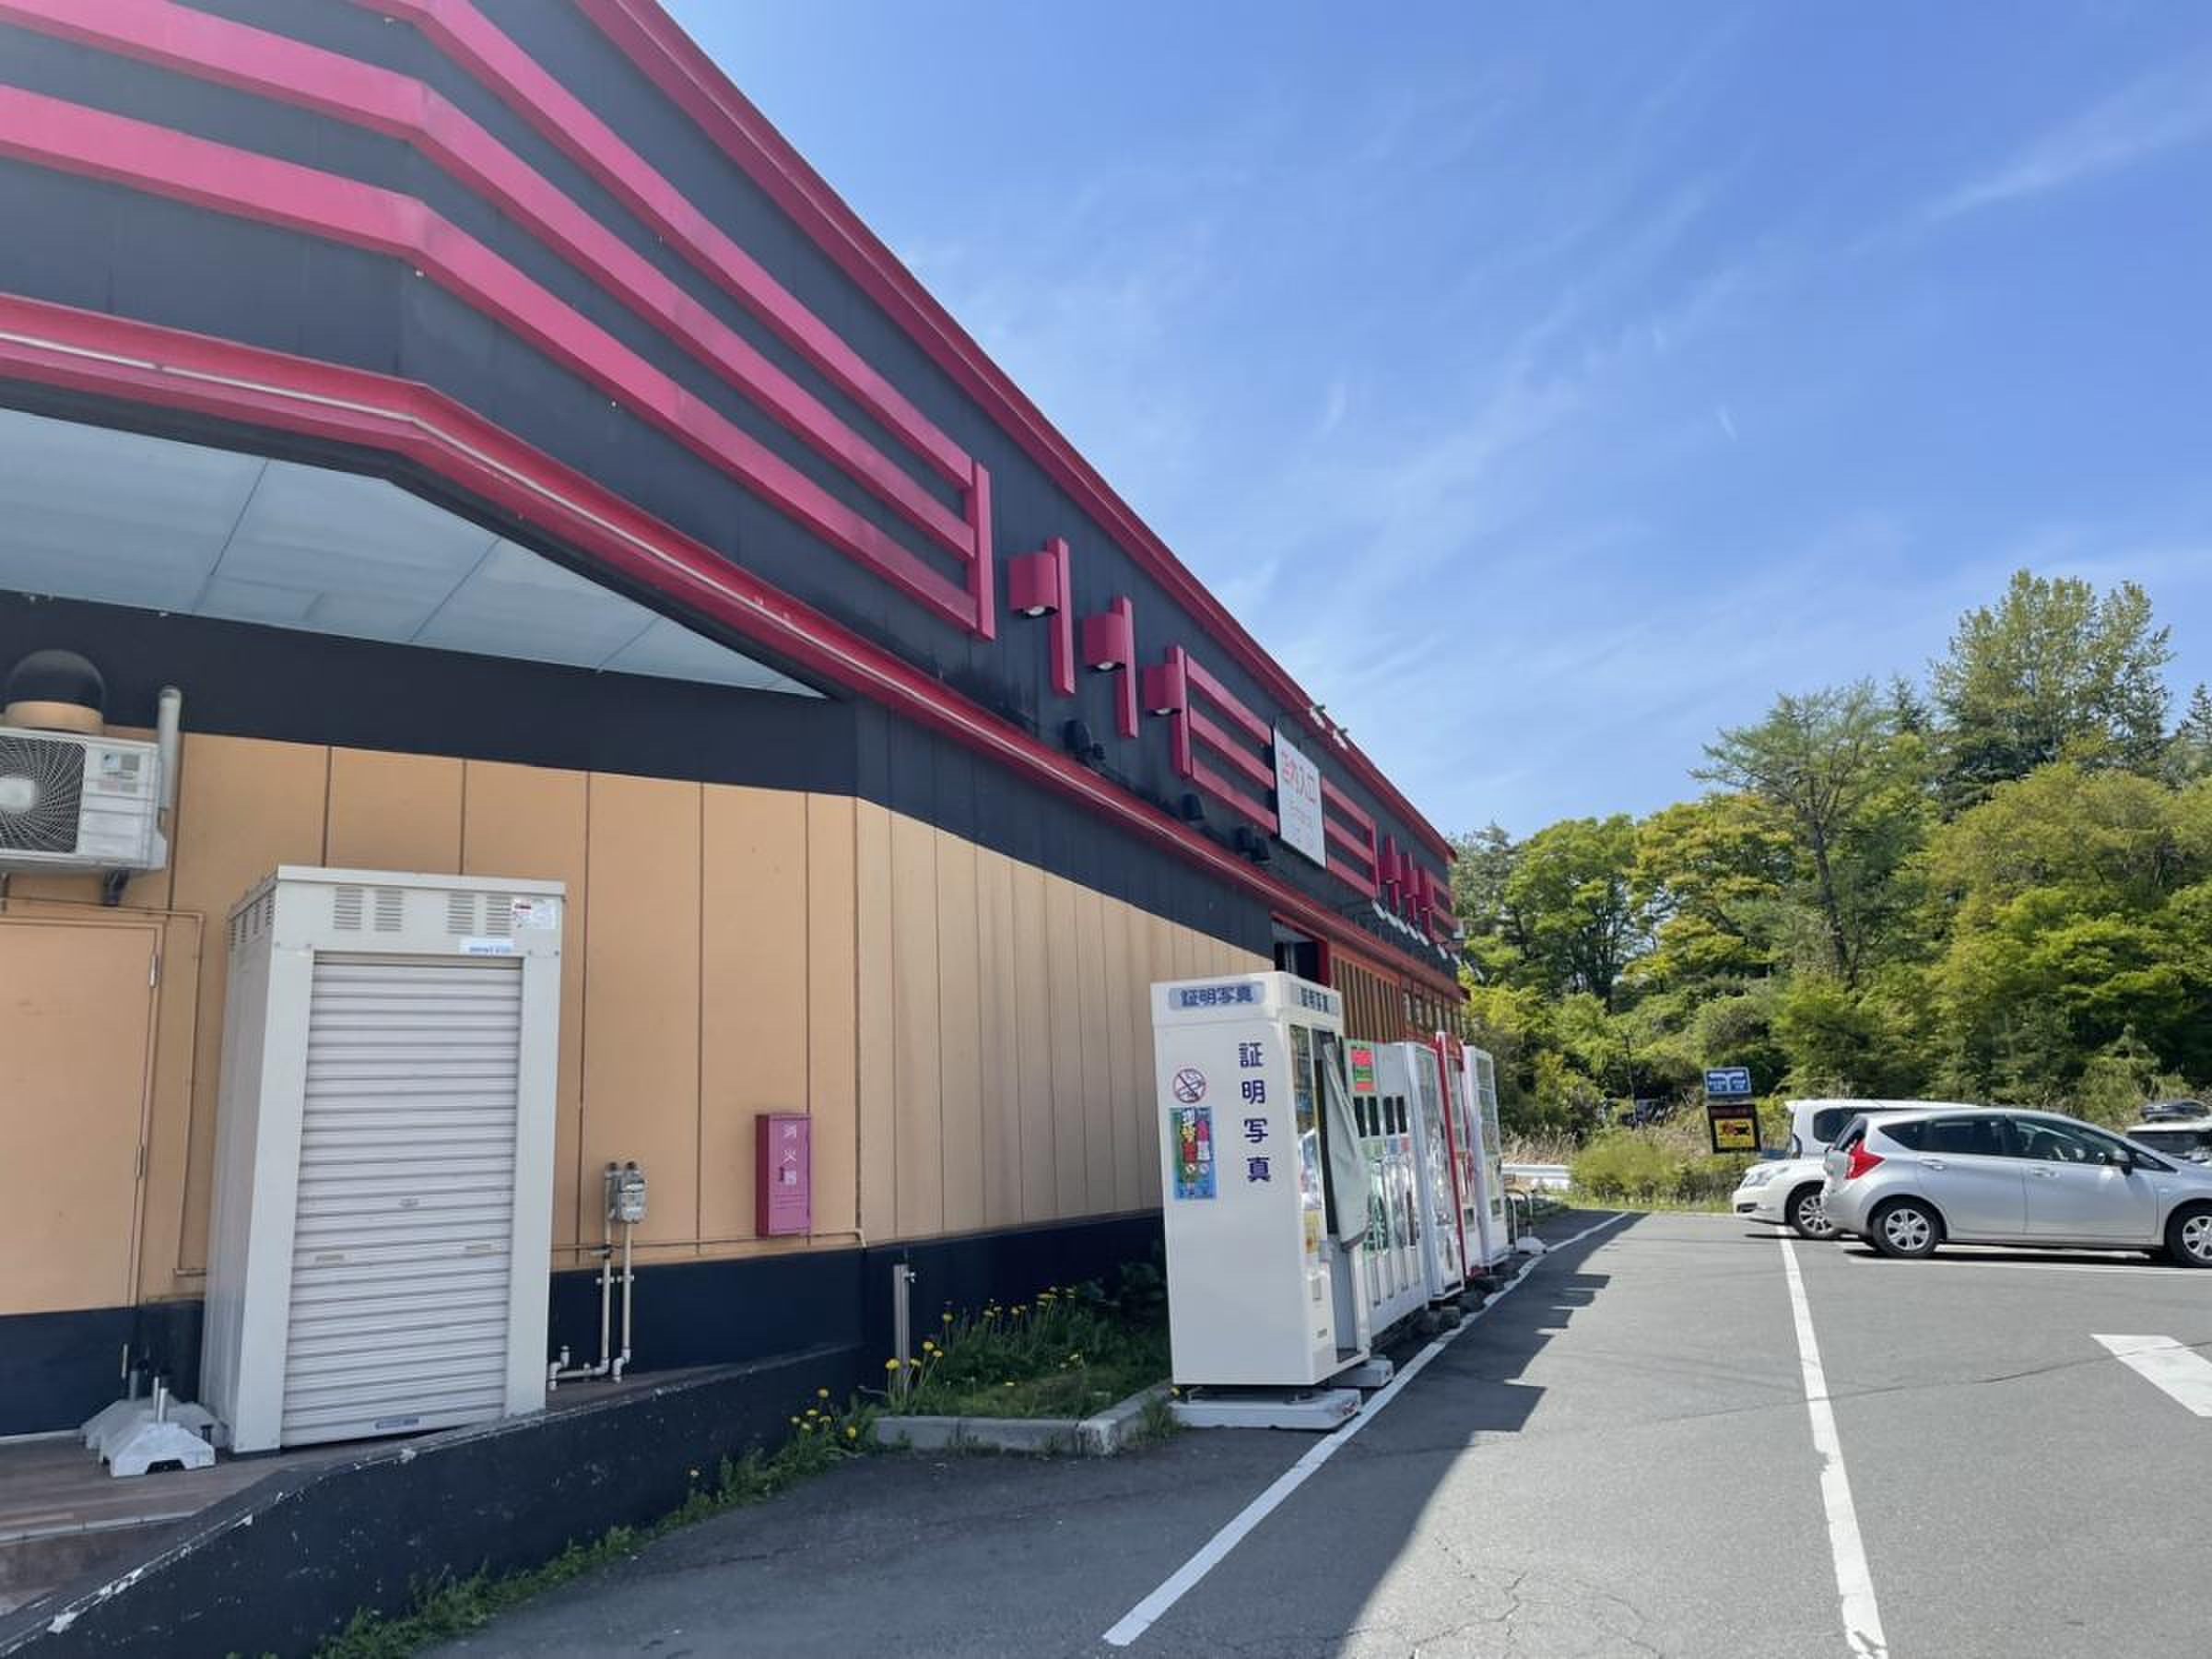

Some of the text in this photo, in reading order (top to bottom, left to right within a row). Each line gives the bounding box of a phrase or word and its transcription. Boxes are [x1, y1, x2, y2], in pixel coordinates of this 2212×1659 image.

[1181, 985, 1253, 1006] 証明写真
[1239, 1042, 1271, 1182] 証明写真
